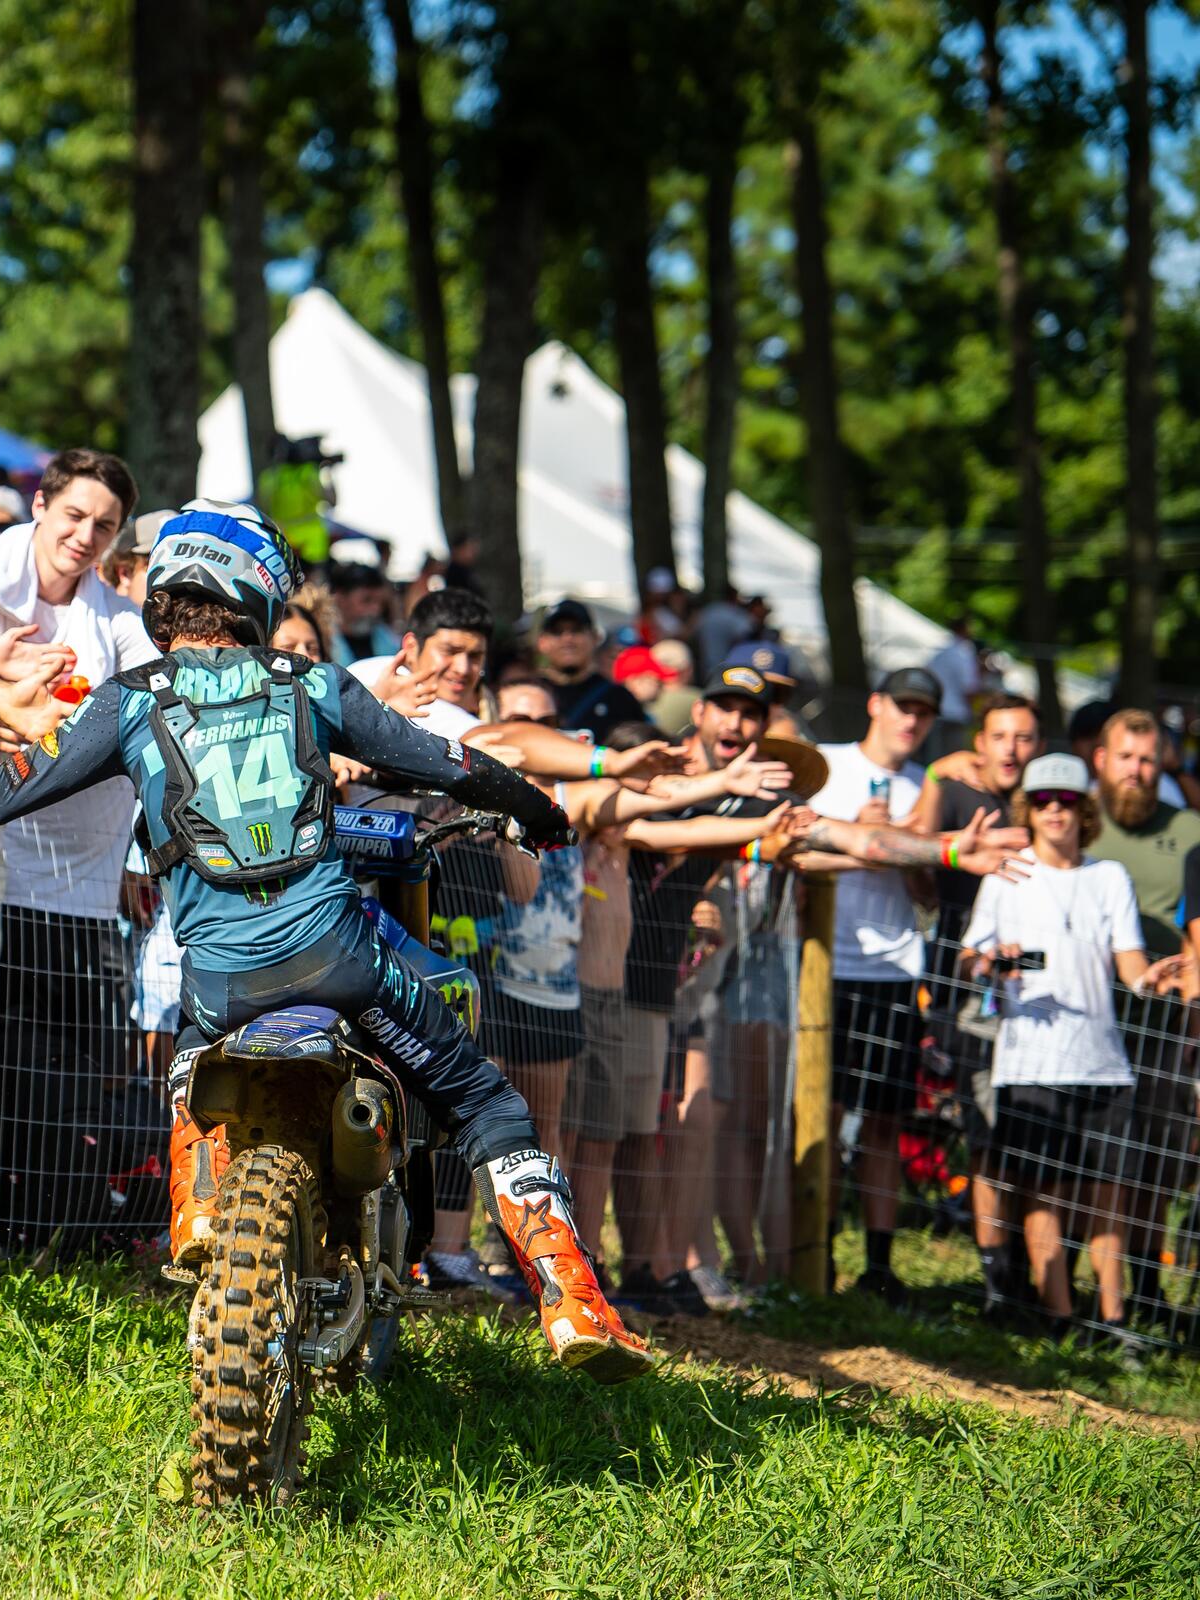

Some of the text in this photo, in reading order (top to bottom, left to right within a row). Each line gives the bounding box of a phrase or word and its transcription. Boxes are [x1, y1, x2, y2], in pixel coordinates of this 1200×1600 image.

[173, 542, 232, 566] Dylan
[256, 564, 274, 591] BELL
[195, 732, 302, 820] 14
[370, 1016, 433, 1070] YAMAHA
